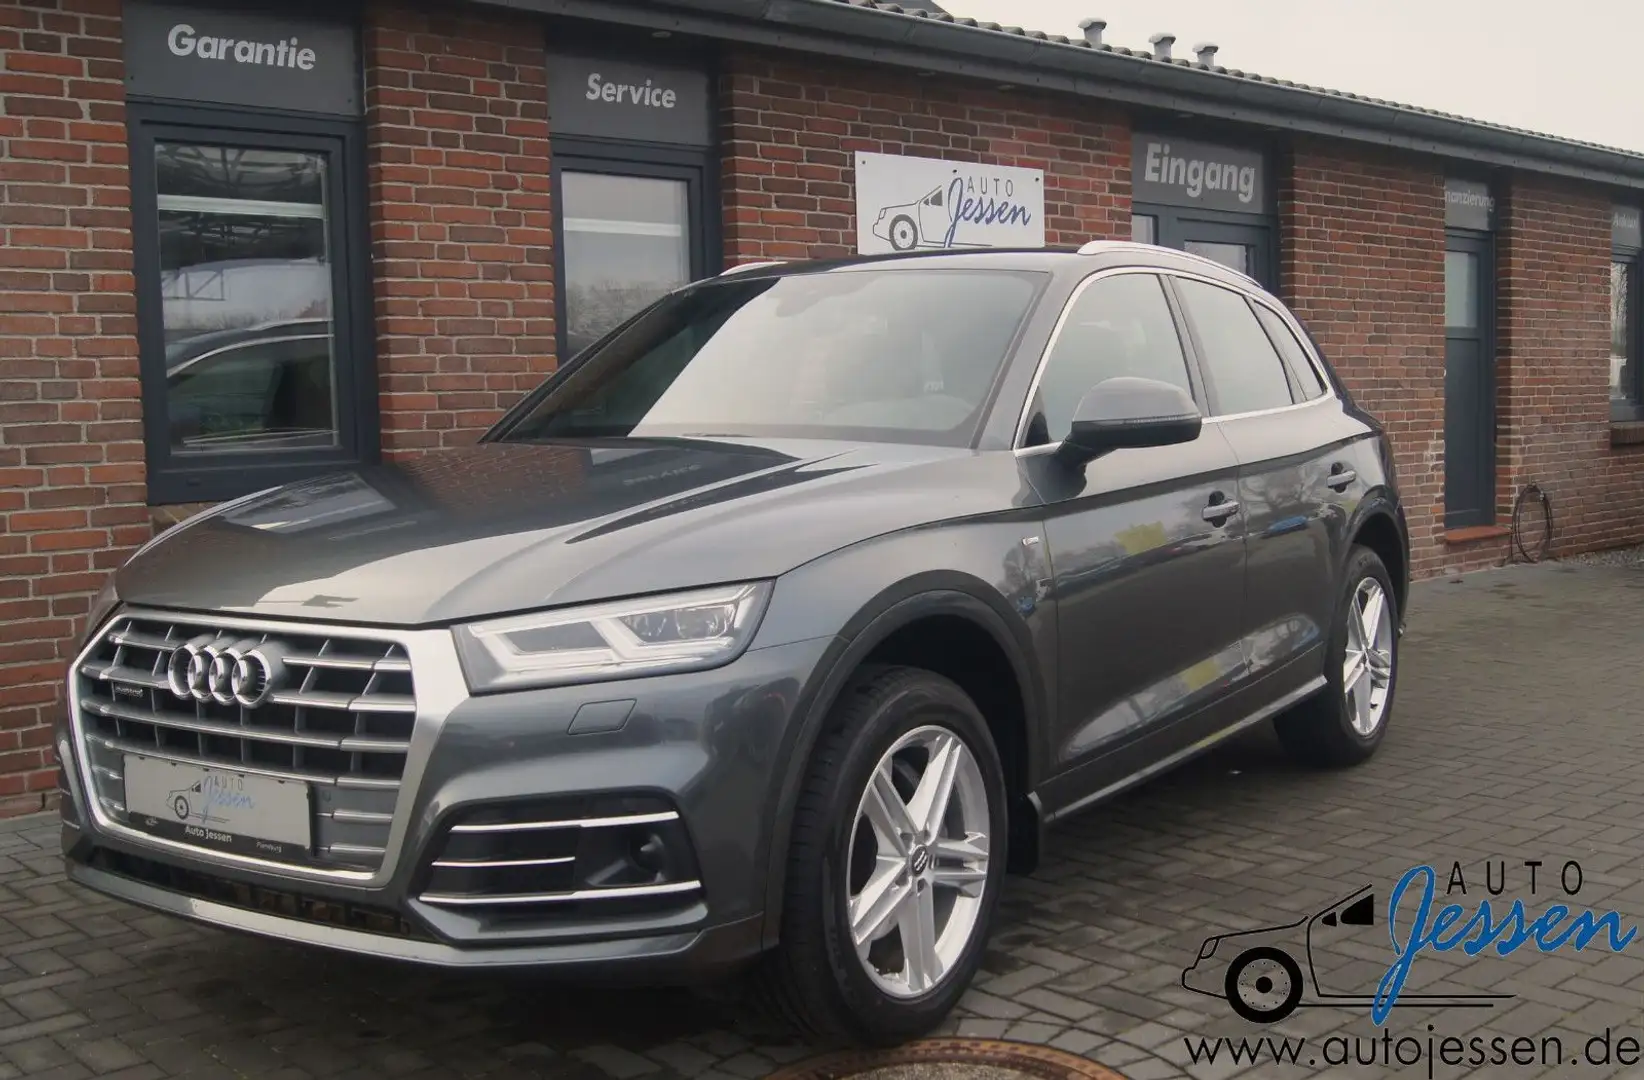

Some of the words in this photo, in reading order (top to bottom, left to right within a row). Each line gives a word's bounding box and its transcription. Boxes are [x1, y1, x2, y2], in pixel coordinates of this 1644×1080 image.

[167, 23, 317, 71] Garantie
[585, 72, 677, 109] Service
[966, 176, 1014, 198] AUTO
[1144, 142, 1256, 204] Eingang
[943, 177, 1032, 249] Jessen
[184, 824, 205, 838] Auto
[205, 828, 233, 843] Jessen
